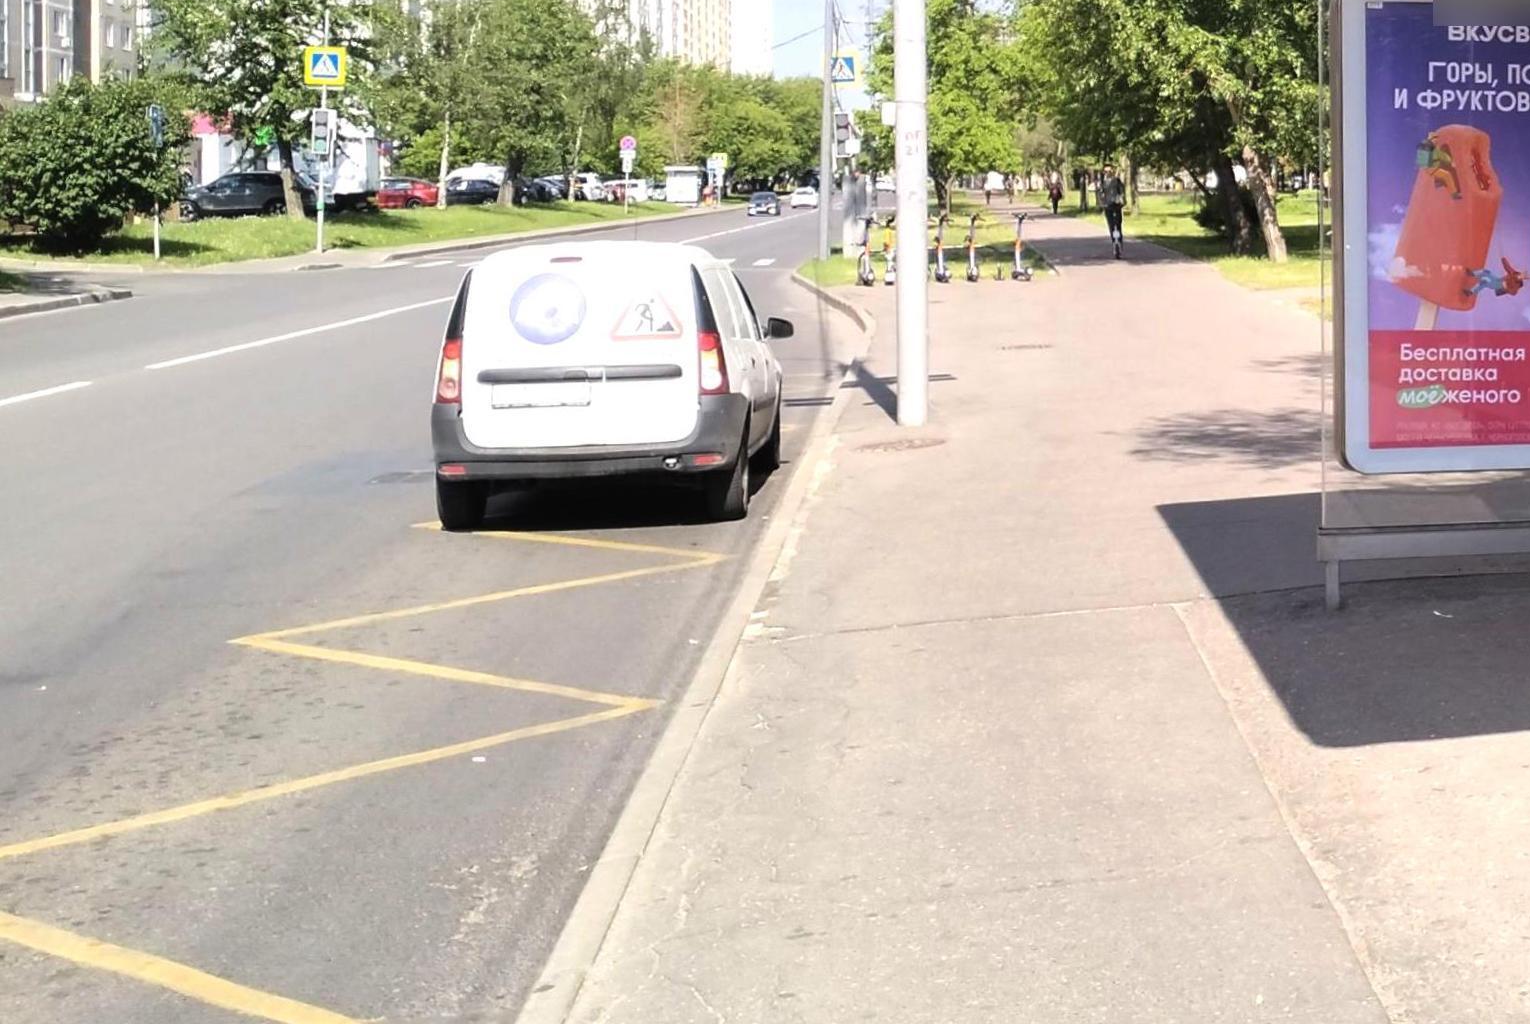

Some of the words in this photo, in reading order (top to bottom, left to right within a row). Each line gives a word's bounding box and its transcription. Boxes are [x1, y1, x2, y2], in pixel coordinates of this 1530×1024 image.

[1428, 61, 1498, 87] ГОРЫ,
[1394, 88, 1408, 110] И
[1399, 343, 1526, 362] Бесплатная
[1398, 367, 1498, 384] доставка
